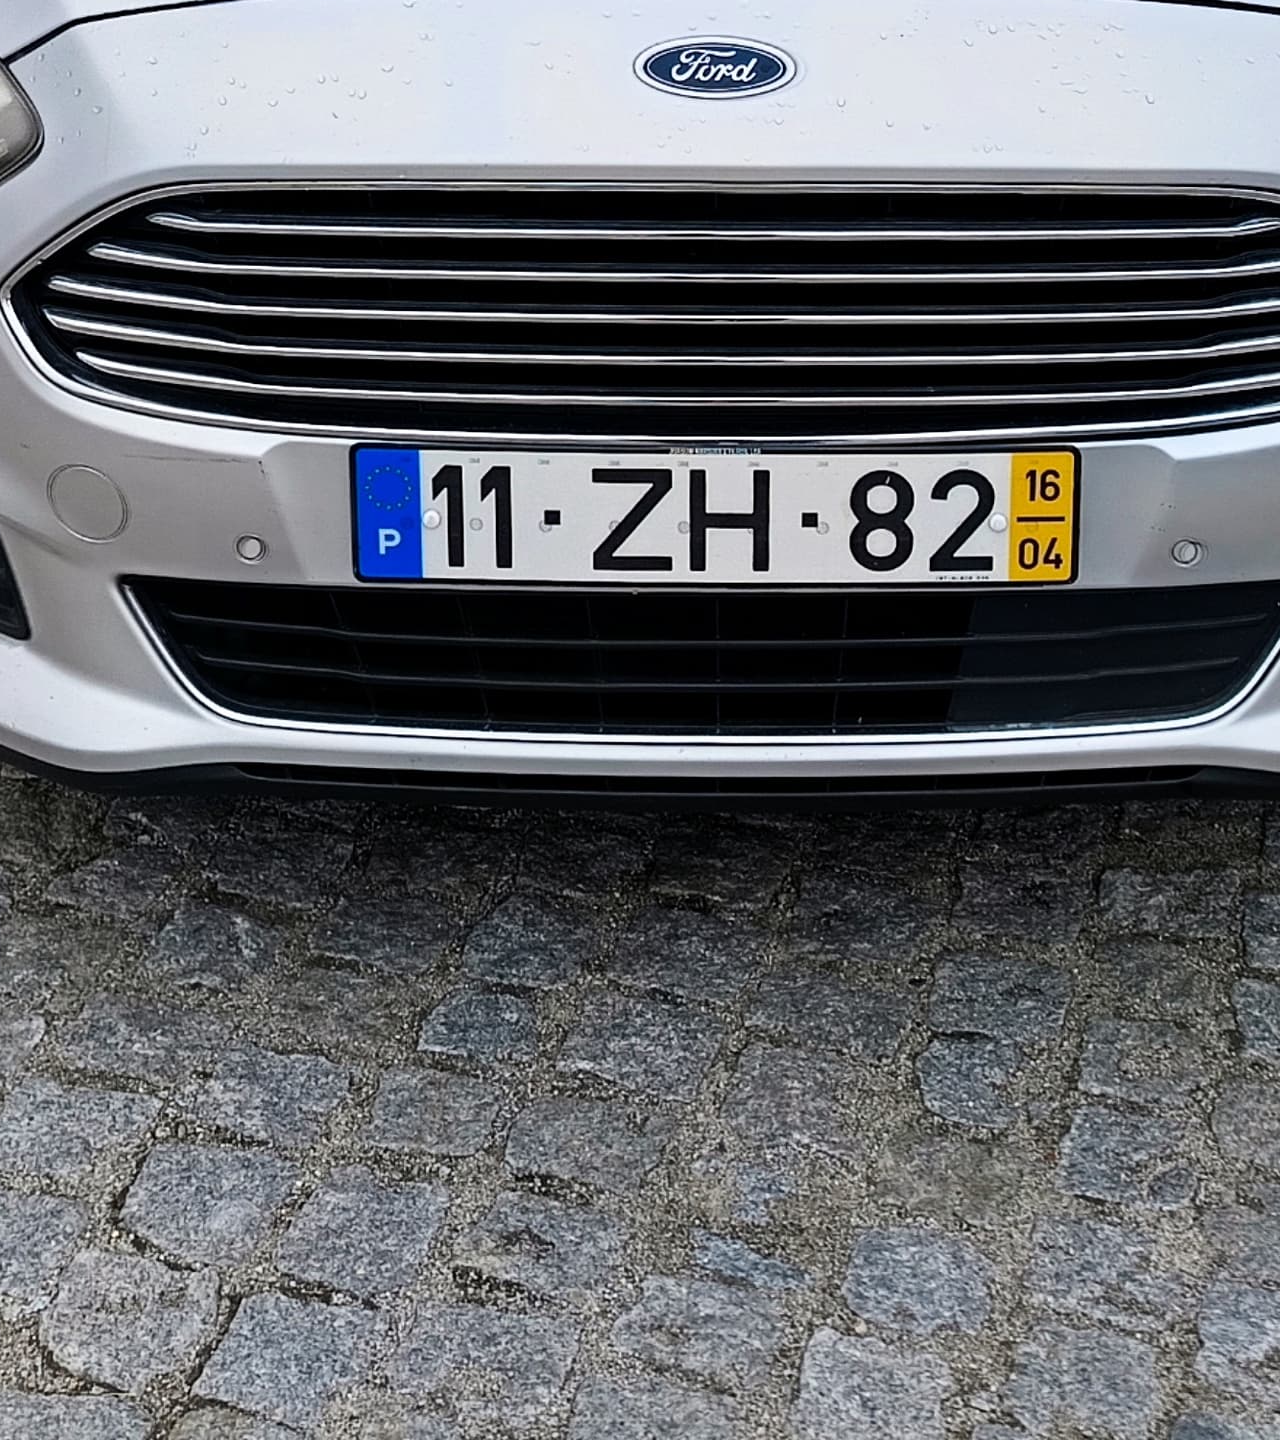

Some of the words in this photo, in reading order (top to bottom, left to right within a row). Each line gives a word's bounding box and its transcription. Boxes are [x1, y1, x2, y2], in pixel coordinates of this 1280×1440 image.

[671, 48, 758, 83] Ford
[1024, 469, 1062, 503] 16
[377, 528, 402, 555] P
[1017, 536, 1064, 571] 04
